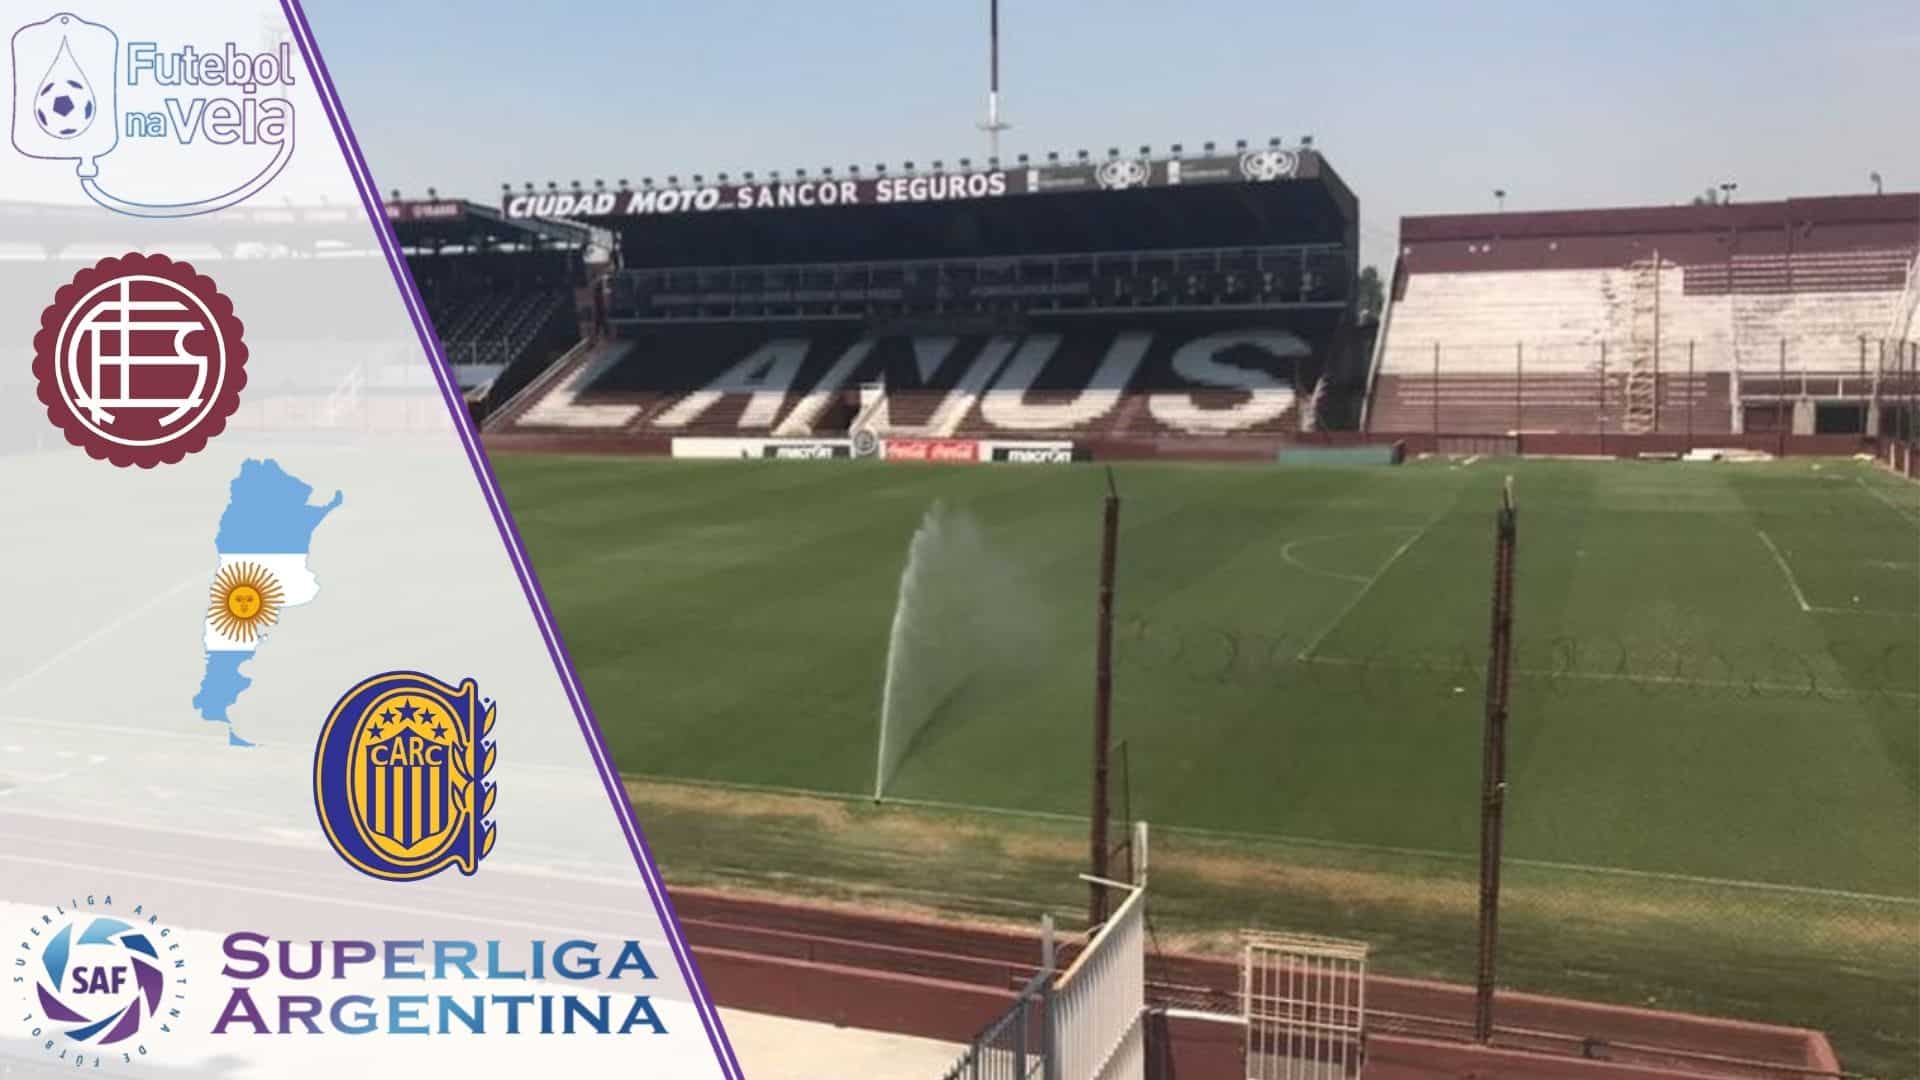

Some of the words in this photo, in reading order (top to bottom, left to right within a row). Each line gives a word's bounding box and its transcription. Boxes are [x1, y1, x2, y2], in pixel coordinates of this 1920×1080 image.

[508, 195, 616, 219] CIUDAD
[625, 187, 720, 214] MOTO
[737, 182, 859, 208] SANCOR
[875, 172, 1006, 202] SEGUROS
[514, 330, 1311, 436] LANUS
